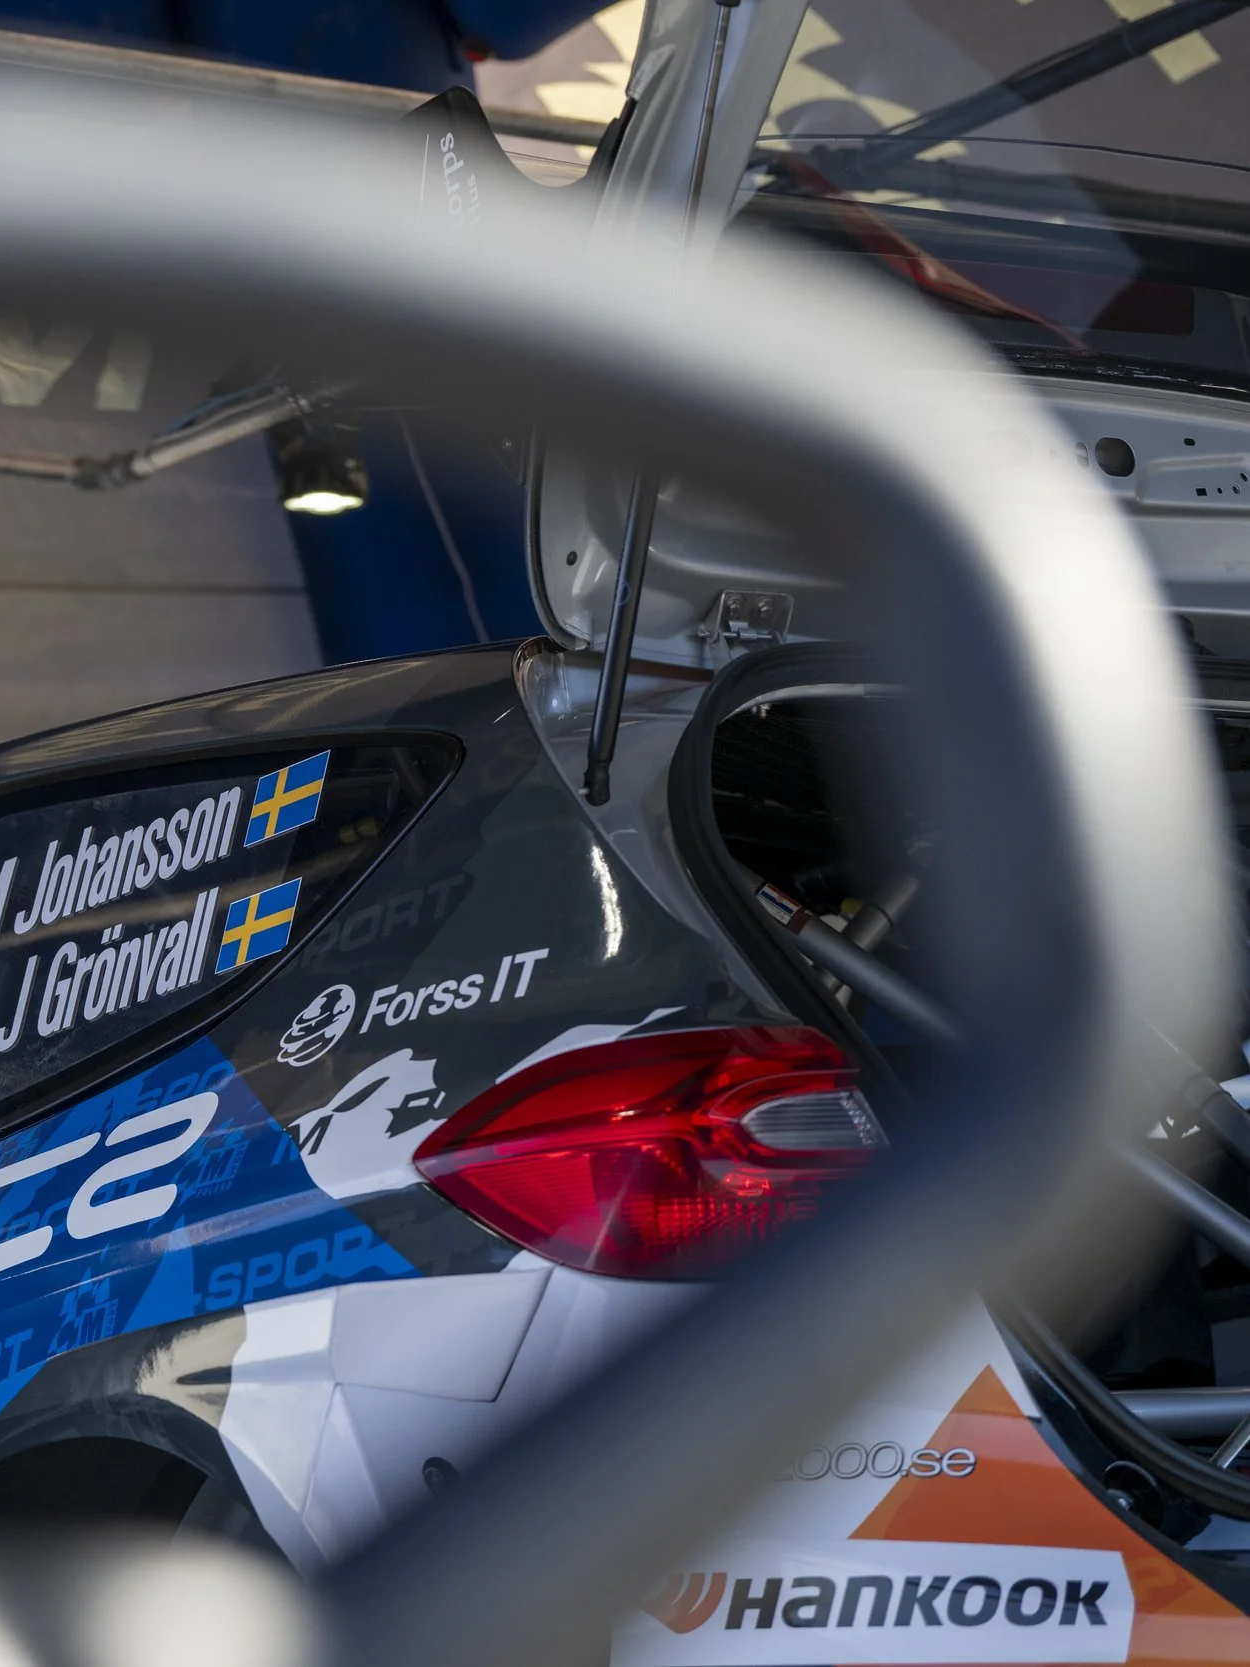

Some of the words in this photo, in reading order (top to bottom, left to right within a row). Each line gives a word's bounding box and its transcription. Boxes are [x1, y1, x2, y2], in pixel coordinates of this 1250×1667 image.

[14, 786, 243, 936] Johansson
[37, 887, 222, 1038] Grönvall
[359, 973, 484, 1035] Forss
[490, 948, 549, 1004] IT
[774, 1440, 977, 1482] 000.se
